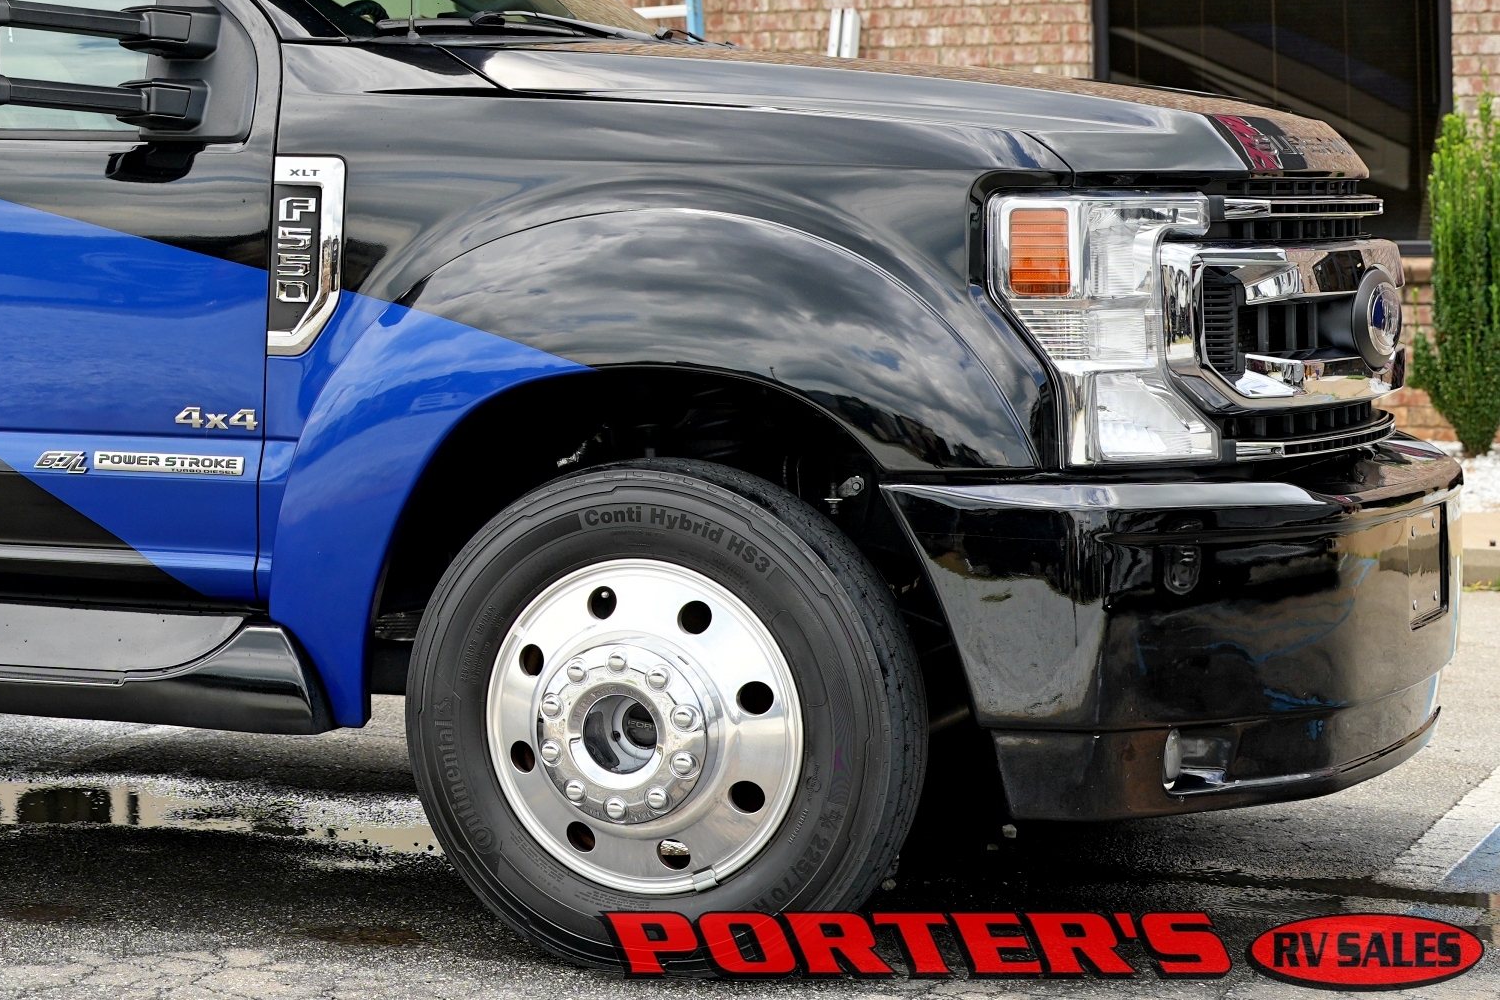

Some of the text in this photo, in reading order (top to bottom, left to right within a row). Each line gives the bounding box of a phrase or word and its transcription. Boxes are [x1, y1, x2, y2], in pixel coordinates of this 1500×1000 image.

[289, 168, 320, 177] XLT
[276, 197, 316, 303] F550
[175, 406, 259, 431] 4x4
[33, 450, 88, 474] 6.7L
[98, 453, 238, 469] POWER STROKE
[584, 506, 771, 574] Conti Hybrid HS3
[434, 719, 497, 854] Continental
